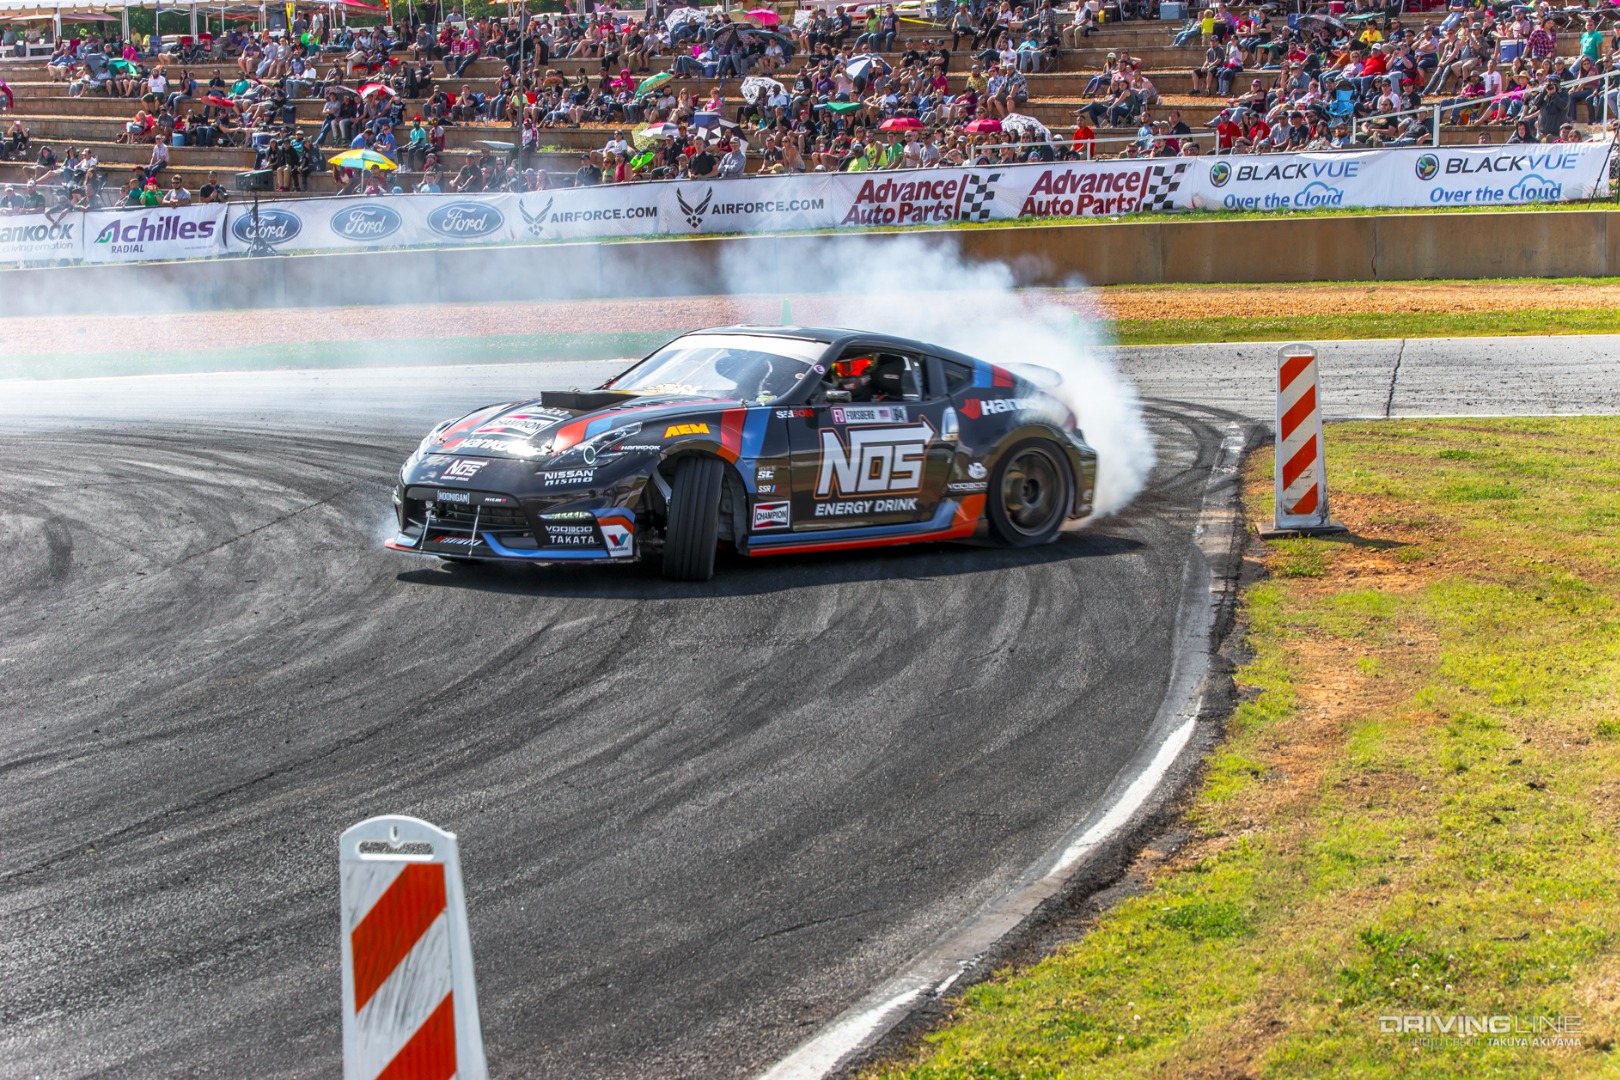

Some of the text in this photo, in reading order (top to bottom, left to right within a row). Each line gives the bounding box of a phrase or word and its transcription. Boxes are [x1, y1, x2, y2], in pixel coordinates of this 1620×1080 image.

[1236, 161, 1359, 181] BLACKVUE
[1445, 153, 1577, 174] BLACKVUE
[855, 178, 957, 204] Advance
[1030, 169, 1140, 195] Advance
[1429, 180, 1562, 203] Over the Cloud
[712, 198, 824, 215] AIRFORCE.COM
[1018, 194, 1135, 218] Auto Parts
[1223, 187, 1344, 210] Over the Cloud
[345, 210, 386, 234] Ford
[442, 207, 488, 232] Ford
[551, 206, 657, 223] AIRFORCE.COM
[841, 200, 952, 225] Auto Parts
[95, 215, 216, 243] Achilles
[246, 214, 288, 239] Ford
[111, 244, 144, 254] RADIAL
[846, 410, 875, 421] FORSBERG
[664, 423, 711, 438] AEM
[444, 459, 487, 476] NOS
[817, 425, 932, 495] NOS
[544, 470, 594, 480] NISSAN
[758, 484, 771, 493] SSR
[757, 510, 787, 521] CHAMPION
[815, 498, 918, 516] ENERGY DRINK
[550, 535, 595, 544] TAKATA
